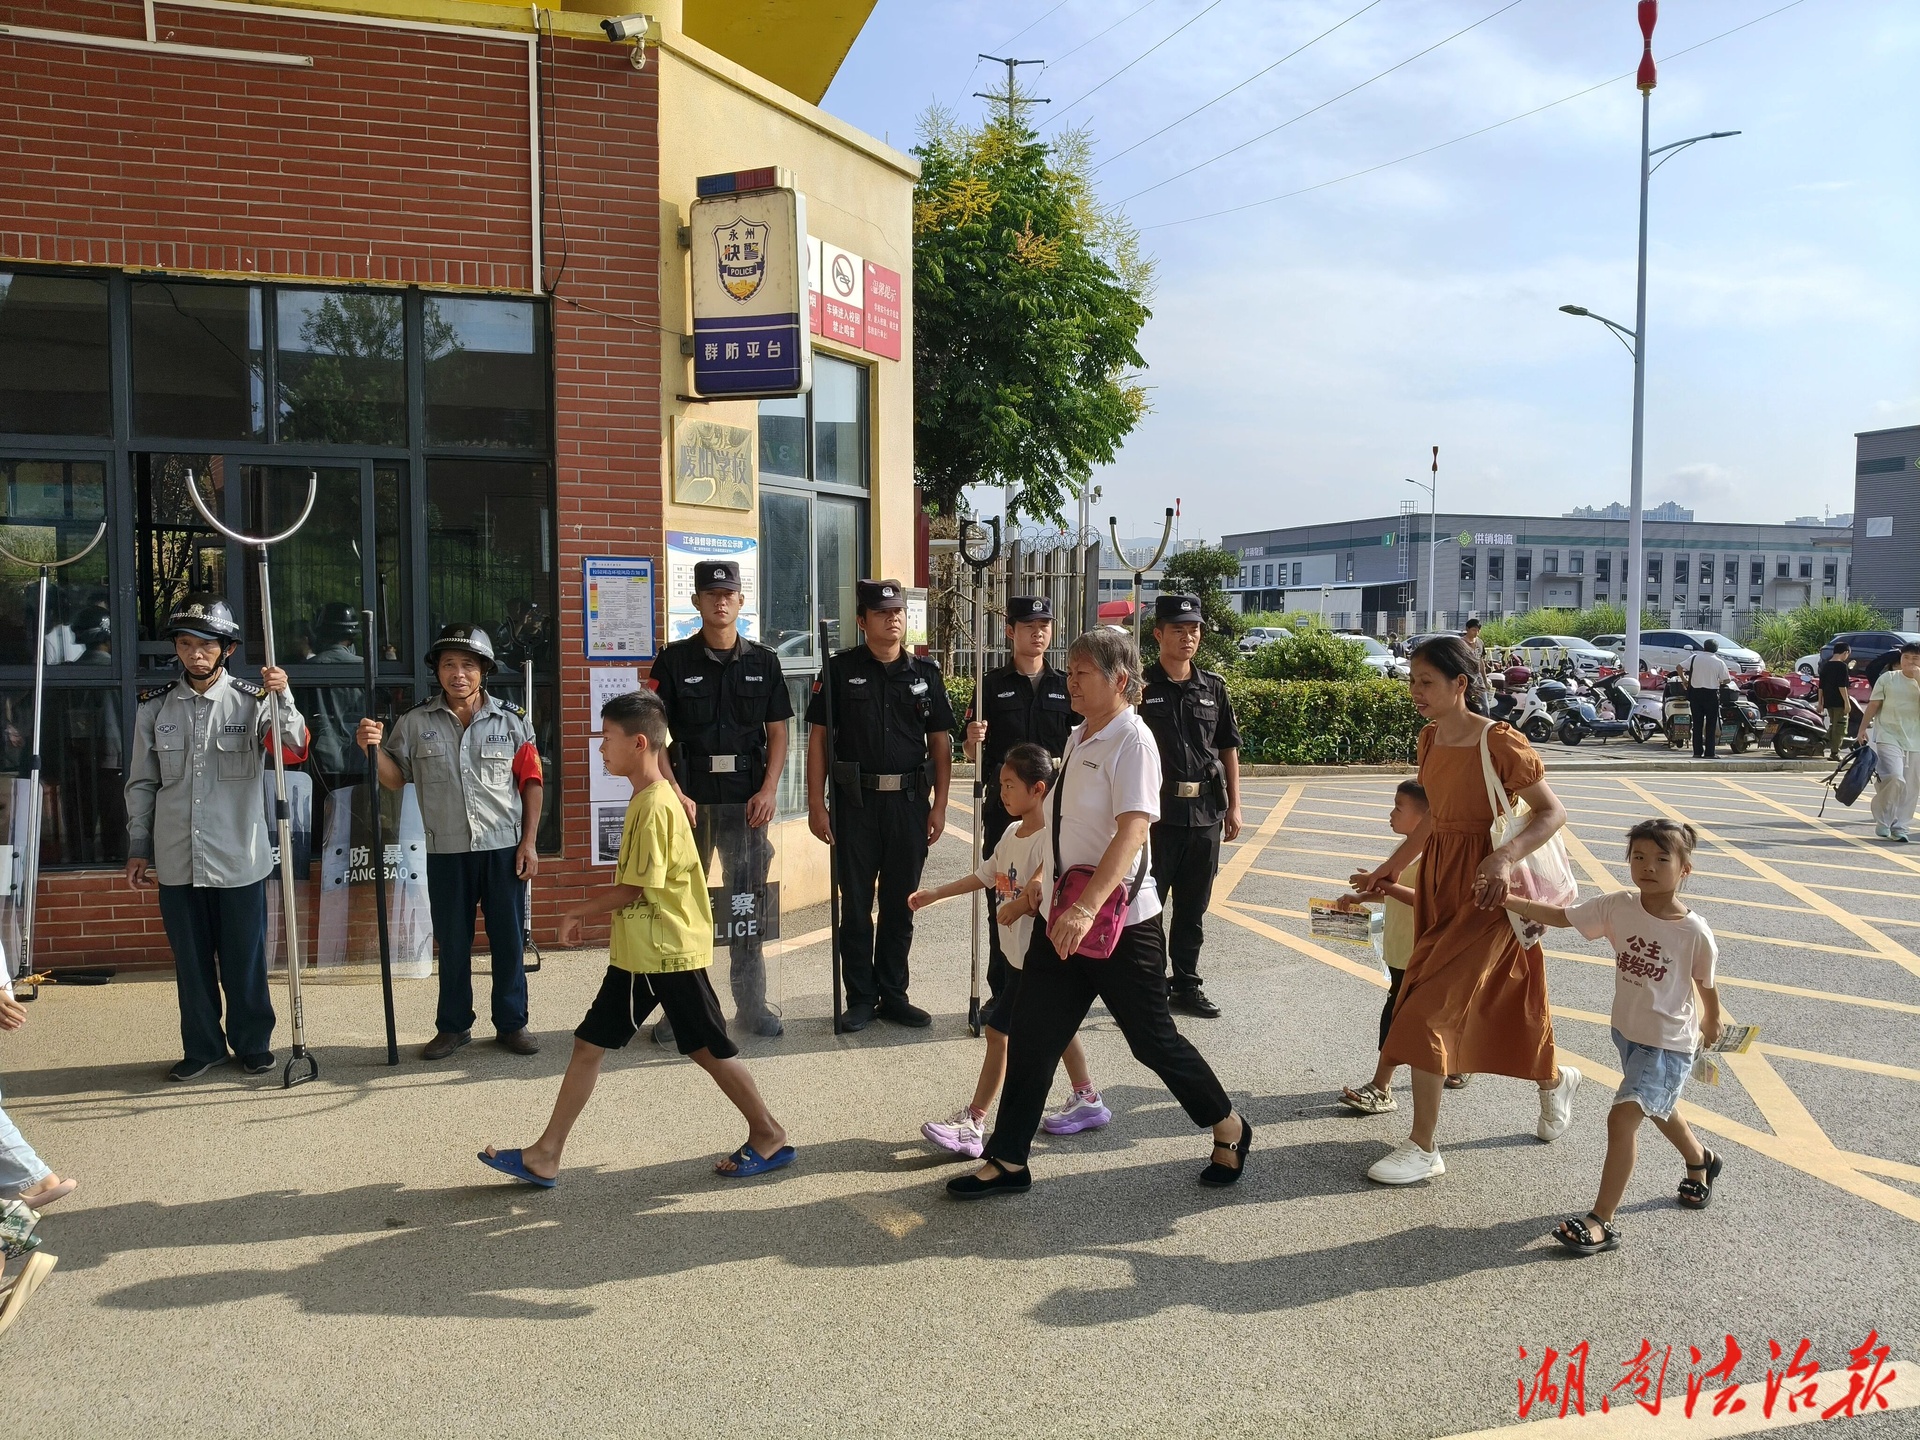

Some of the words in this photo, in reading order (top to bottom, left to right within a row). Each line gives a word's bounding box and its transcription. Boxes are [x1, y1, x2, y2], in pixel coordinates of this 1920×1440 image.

[728, 227, 755, 241] 永州
[723, 242, 759, 261] 快警
[730, 267, 754, 276] POLICE
[826, 303, 861, 325] 车辆进入校园
[832, 320, 855, 339] 禁止鸣笛
[704, 340, 782, 361] 群防平台
[1474, 532, 1514, 545] 供销物流
[350, 844, 404, 867] 防暴
[343, 867, 377, 883] FANG
[1626, 934, 1662, 961] 公主
[1616, 951, 1668, 982] 请发财
